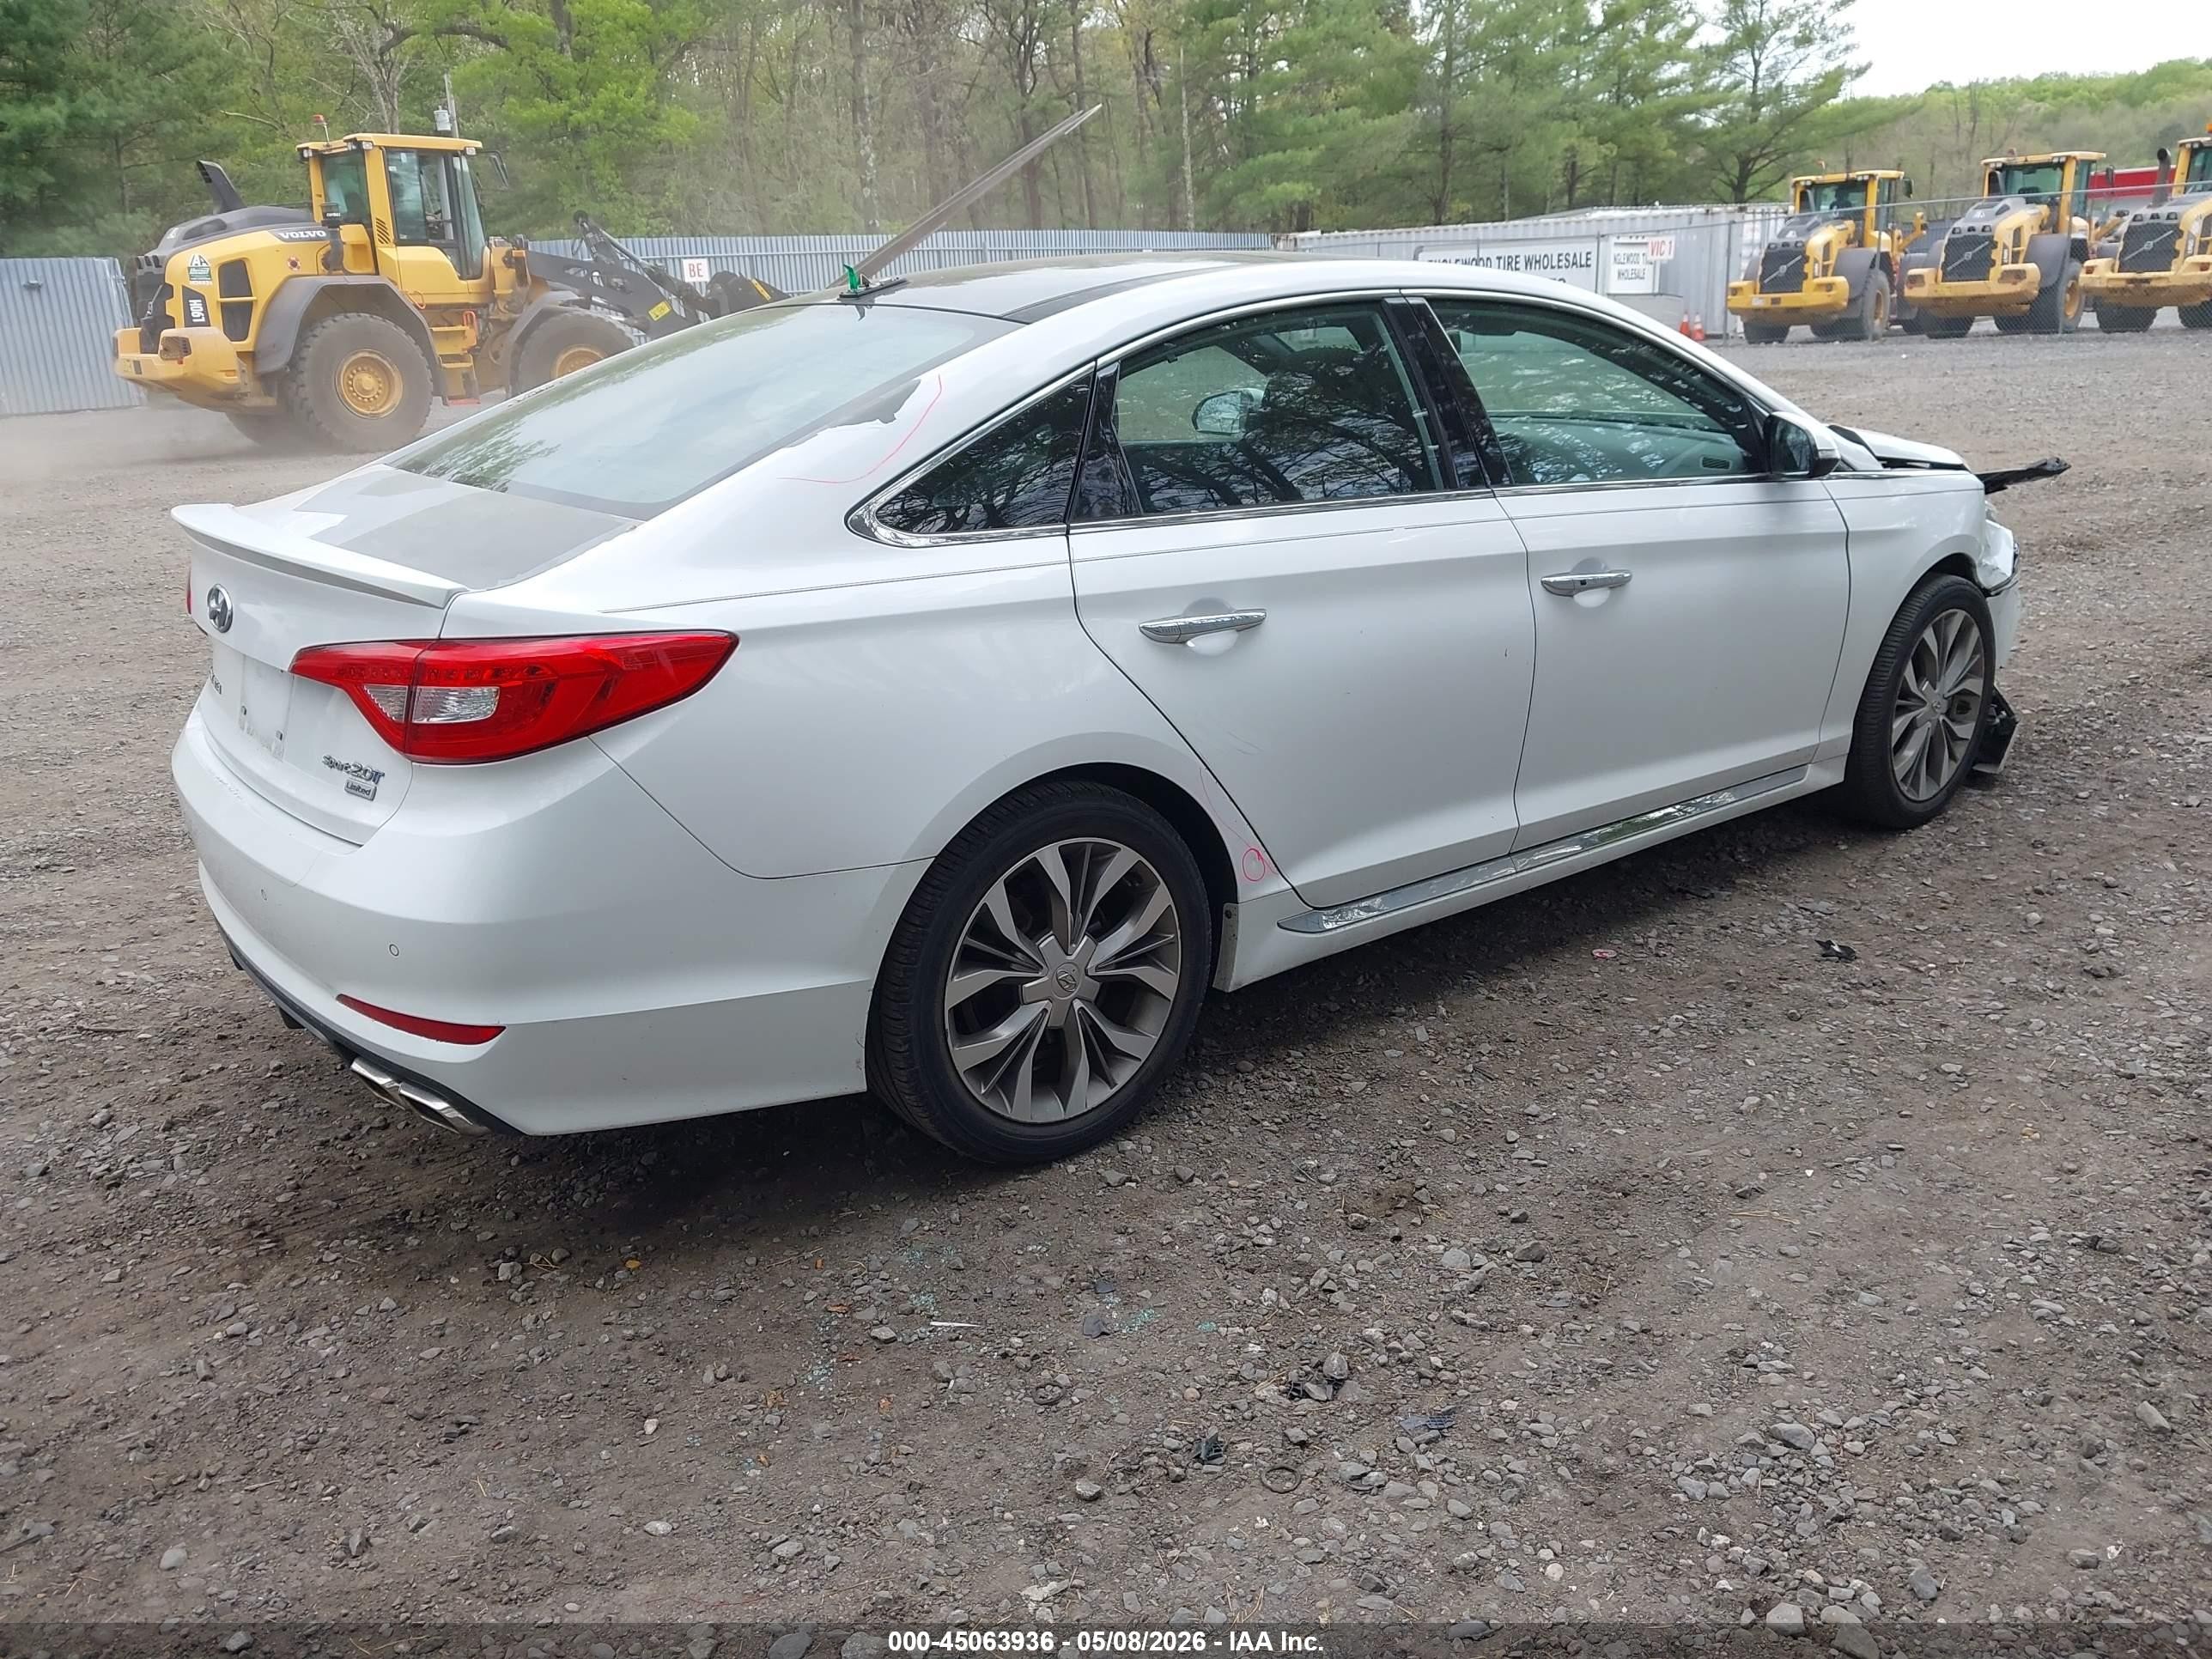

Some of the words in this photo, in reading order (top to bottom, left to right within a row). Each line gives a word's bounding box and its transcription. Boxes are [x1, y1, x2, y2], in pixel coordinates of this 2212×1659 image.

[277, 230, 327, 240] VOLVO
[1650, 240, 1666, 256] VIC
[1496, 254, 1521, 271] TIRE
[1523, 251, 1593, 270] WHOLESALE
[688, 262, 704, 278] BE
[188, 299, 206, 323] L90H
[346, 781, 372, 796] Limited
